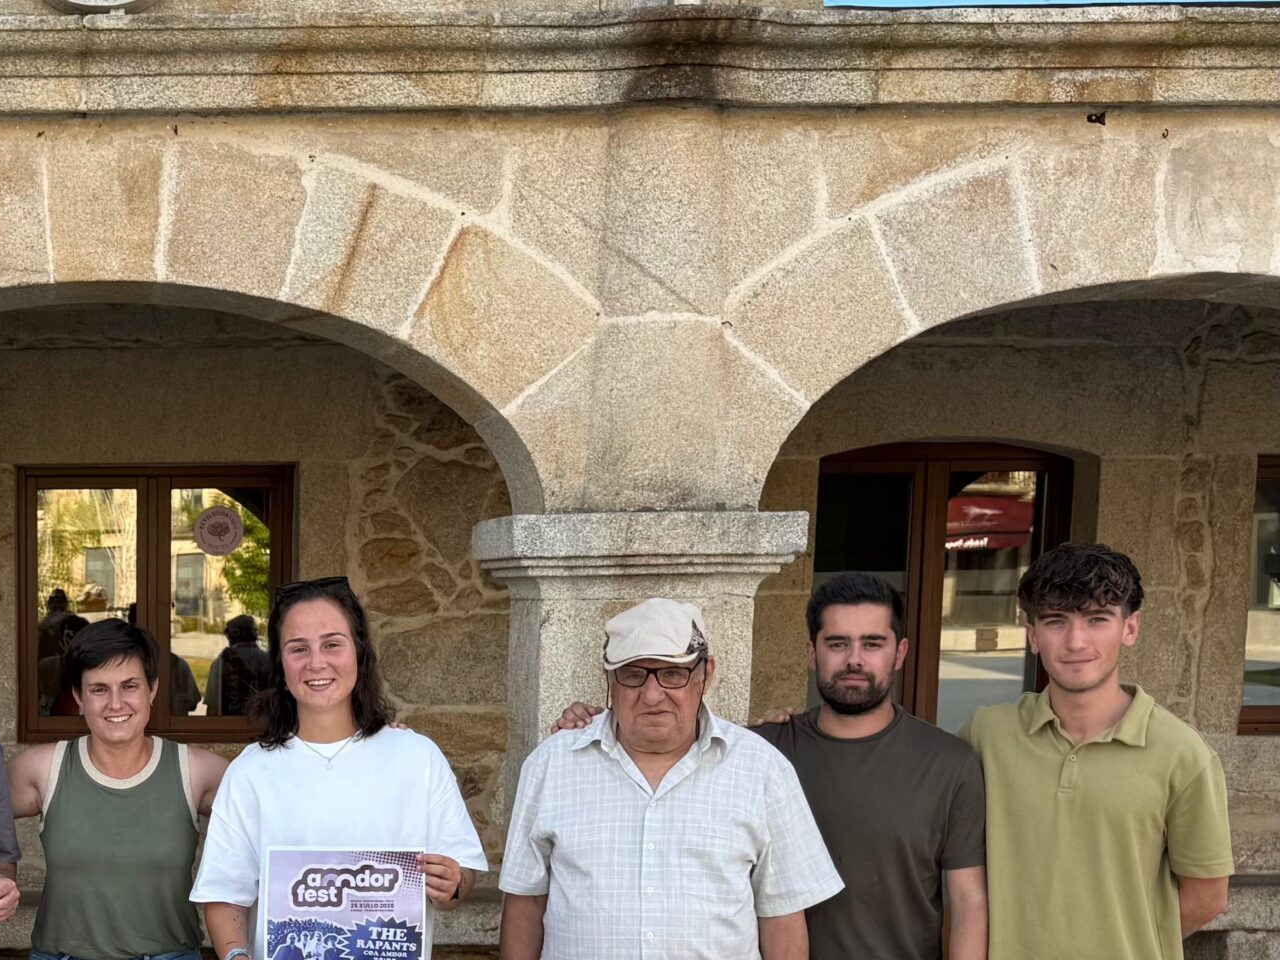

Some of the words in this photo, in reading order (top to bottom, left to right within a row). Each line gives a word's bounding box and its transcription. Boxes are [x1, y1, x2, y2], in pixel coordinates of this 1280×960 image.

[297, 884, 338, 902] fest
[368, 926, 407, 941] THE
[356, 939, 417, 951] RAPANTS
